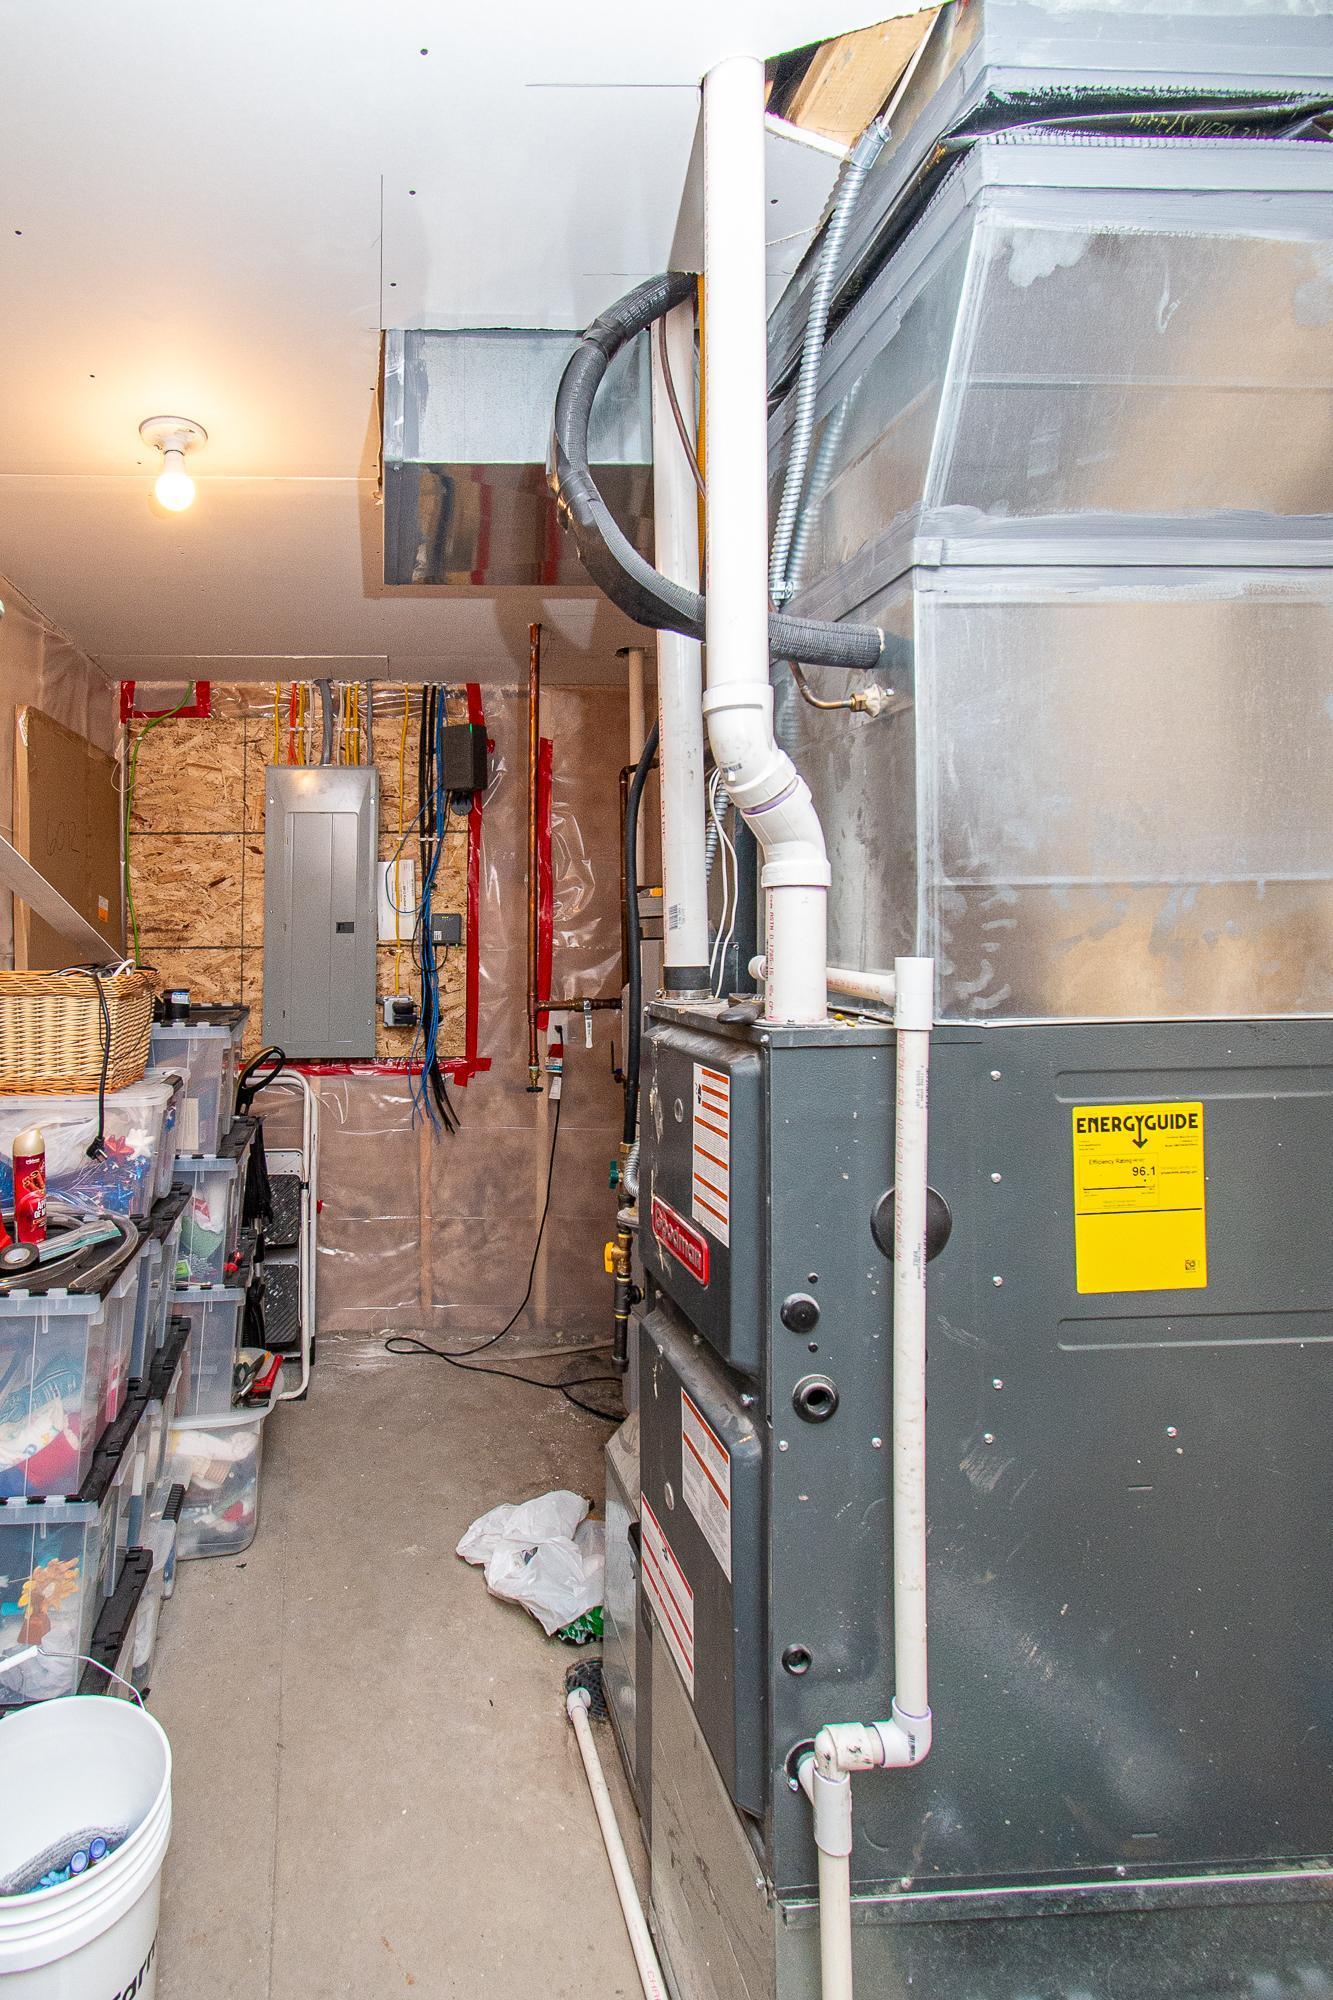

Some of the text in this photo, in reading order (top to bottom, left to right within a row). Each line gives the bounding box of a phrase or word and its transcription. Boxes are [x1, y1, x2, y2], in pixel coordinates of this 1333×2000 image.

[1076, 1113, 1198, 1134] ENERGYGUIDE
[1132, 1166, 1156, 1176] 96.1
[655, 1207, 702, 1270] Goodman
